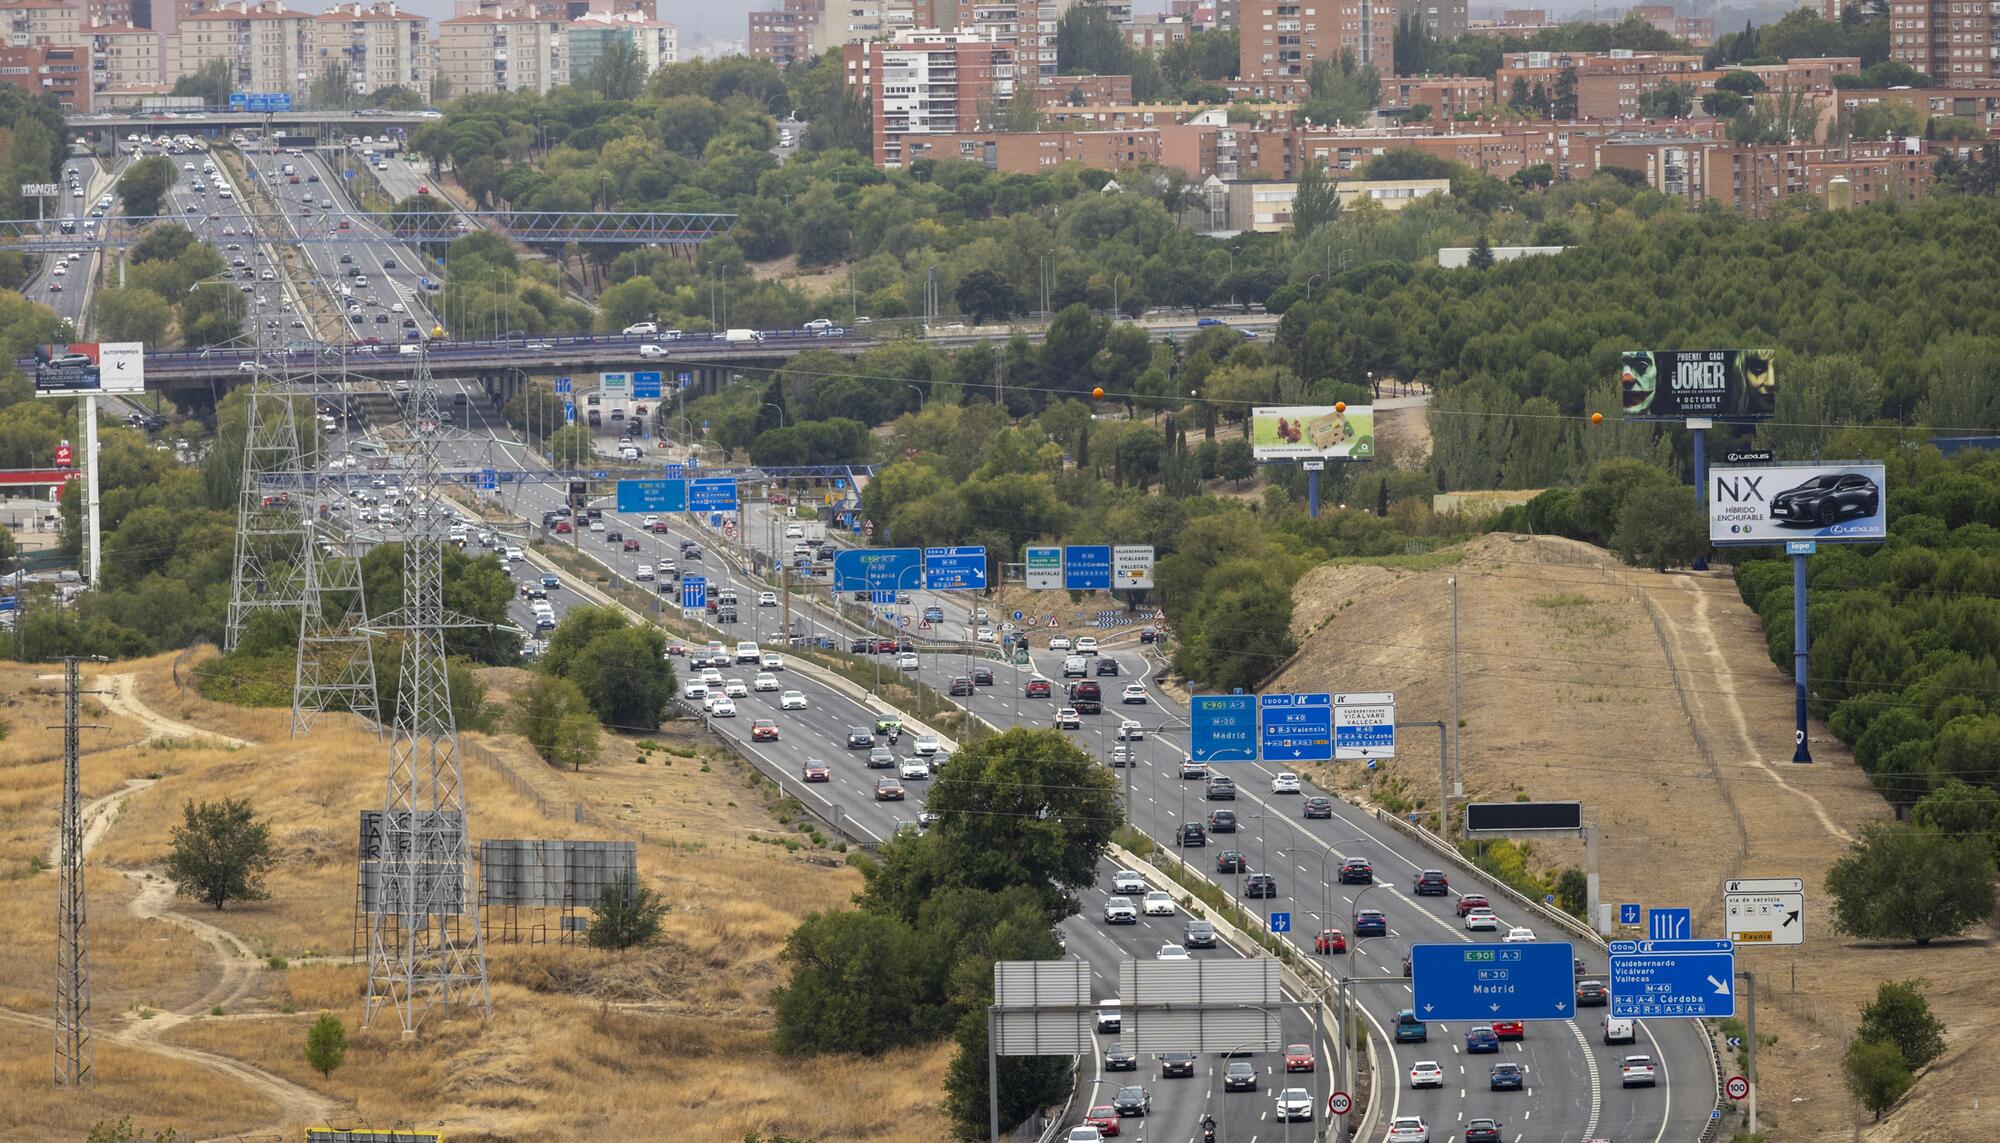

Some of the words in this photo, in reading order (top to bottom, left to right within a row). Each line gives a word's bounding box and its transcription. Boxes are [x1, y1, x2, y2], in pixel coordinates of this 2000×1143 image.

[1709, 352, 1724, 361] GAGA
[1671, 361, 1725, 390] JOKER
[1717, 476, 1764, 502] NX
[1725, 505, 1756, 514] HÍBRIDO
[1466, 952, 1494, 960] E-901
[1502, 951, 1520, 960] A-3
[1615, 960, 1676, 968] Valdebernardo
[1480, 970, 1507, 979] M-30
[1615, 967, 1655, 975] Vicálvaro
[1615, 975, 1650, 983] Vallecas
[1473, 984, 1515, 993] Madrid
[1646, 984, 1670, 992] M-40
[1660, 994, 1704, 1003] Córdoba
[1616, 1006, 1639, 1014] A-42
[1644, 1005, 1660, 1013] R-5
[1730, 1084, 1745, 1092] 100
[1333, 1099, 1347, 1107] 100
